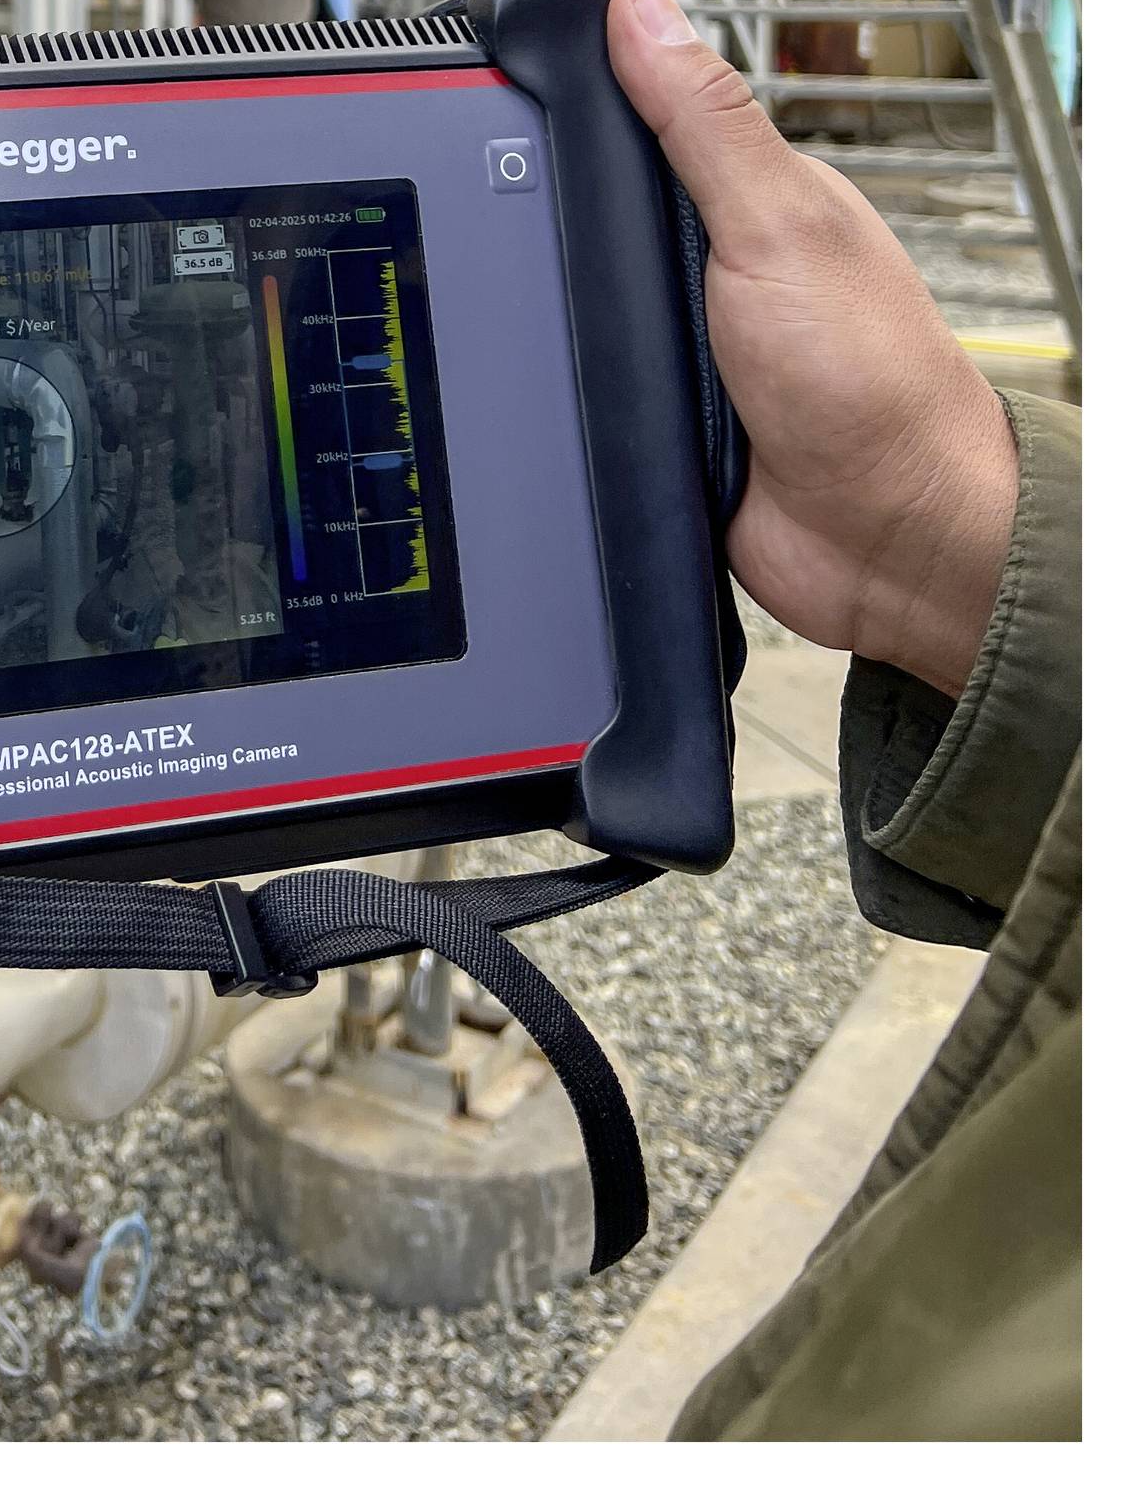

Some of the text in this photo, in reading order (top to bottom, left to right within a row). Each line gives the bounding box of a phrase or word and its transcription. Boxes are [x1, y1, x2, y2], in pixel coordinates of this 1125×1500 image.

[249, 212, 352, 228] 02-04-2025 01:42:26
[252, 249, 287, 261] 36.5dB
[294, 246, 327, 258] 50kHz
[184, 257, 223, 269] 36.5 dB
[302, 314, 334, 325] 40kHz
[309, 382, 342, 394] 30kHz
[316, 451, 349, 464] 20kHz
[324, 521, 357, 533] 10kHz
[287, 595, 323, 609] 35.5dB
[240, 611, 276, 625] 5.25 ft
[75, 763, 153, 786] Acoustic
[158, 753, 228, 776] Imaging
[232, 743, 298, 764] Camera
